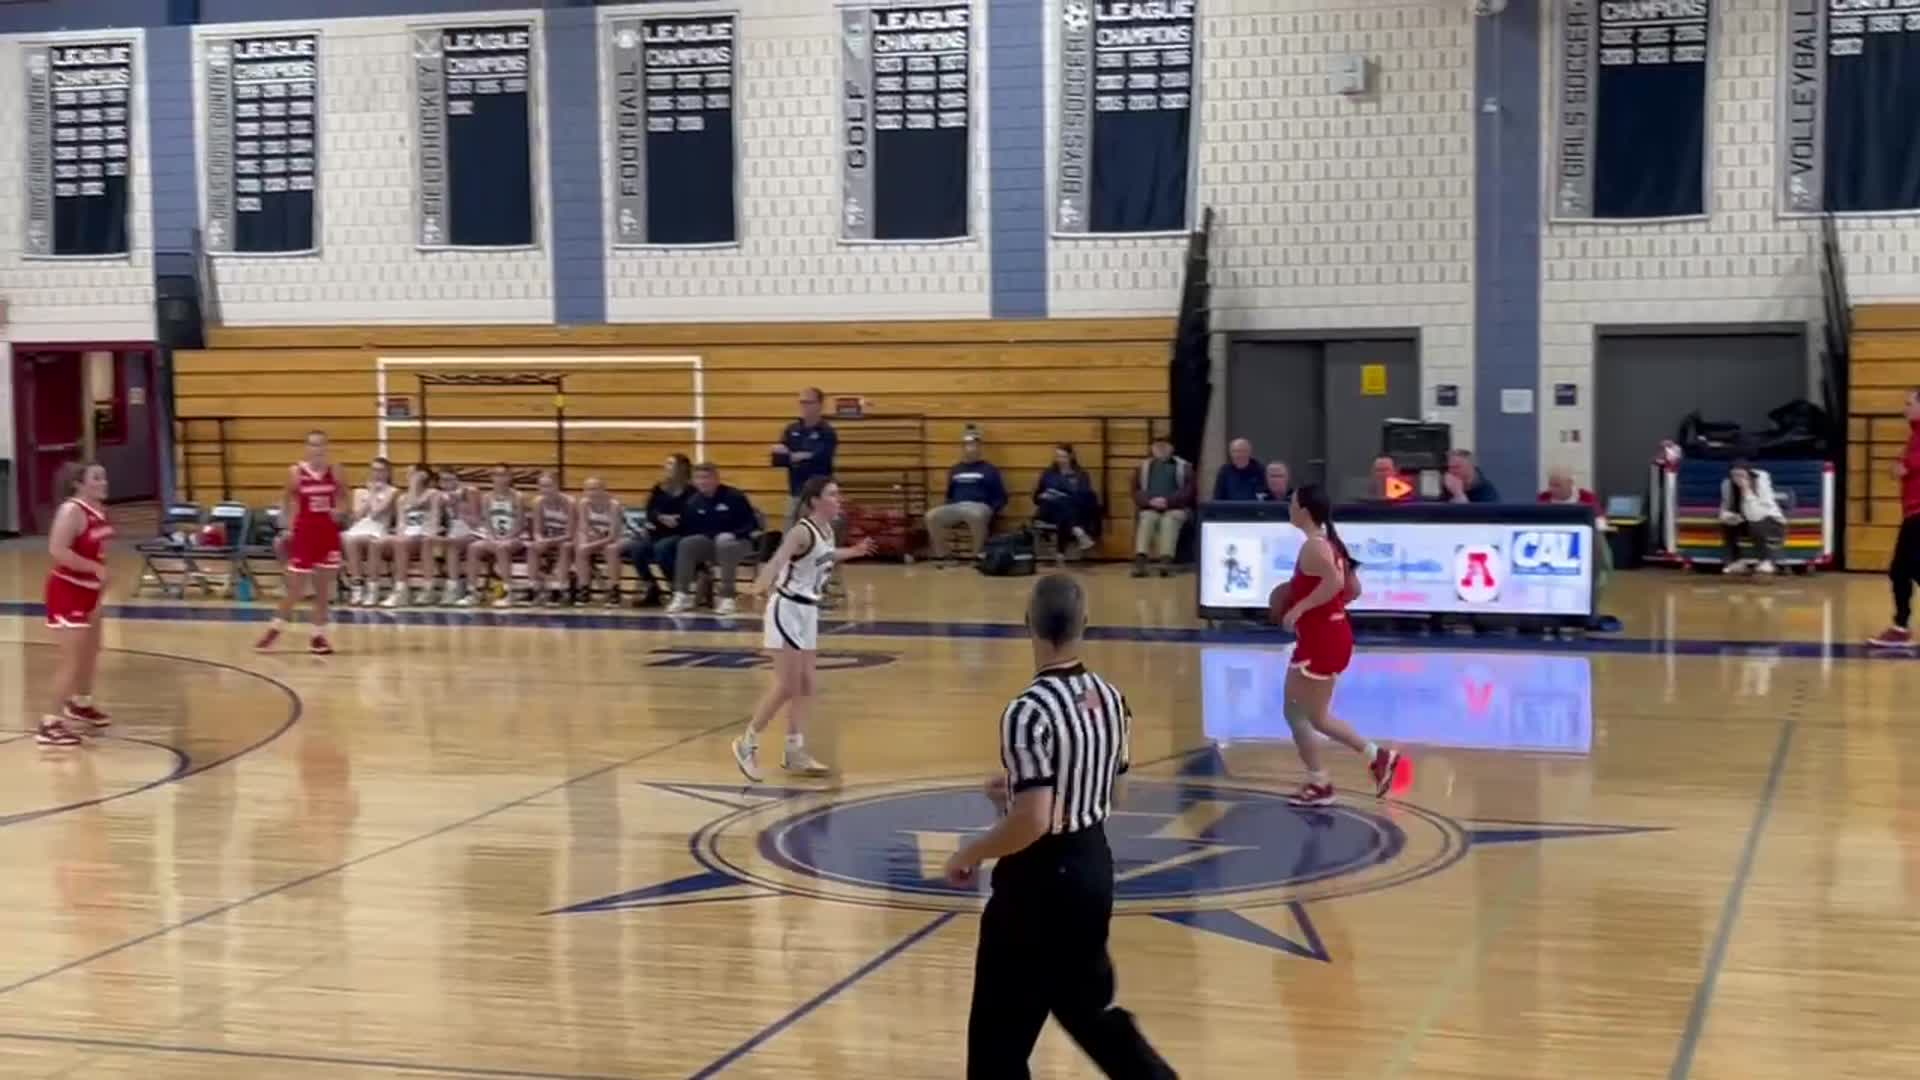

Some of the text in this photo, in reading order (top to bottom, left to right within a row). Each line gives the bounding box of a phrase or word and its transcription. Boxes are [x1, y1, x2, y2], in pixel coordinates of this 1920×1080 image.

[872, 8, 970, 30] LEAGUE
[1095, 0, 1193, 20] LEAGUE
[1791, 0, 1818, 175] VOLLEYBALL
[618, 61, 639, 197] FOOTBALL
[846, 80, 867, 169] GOLF
[1514, 532, 1580, 568] CAL
